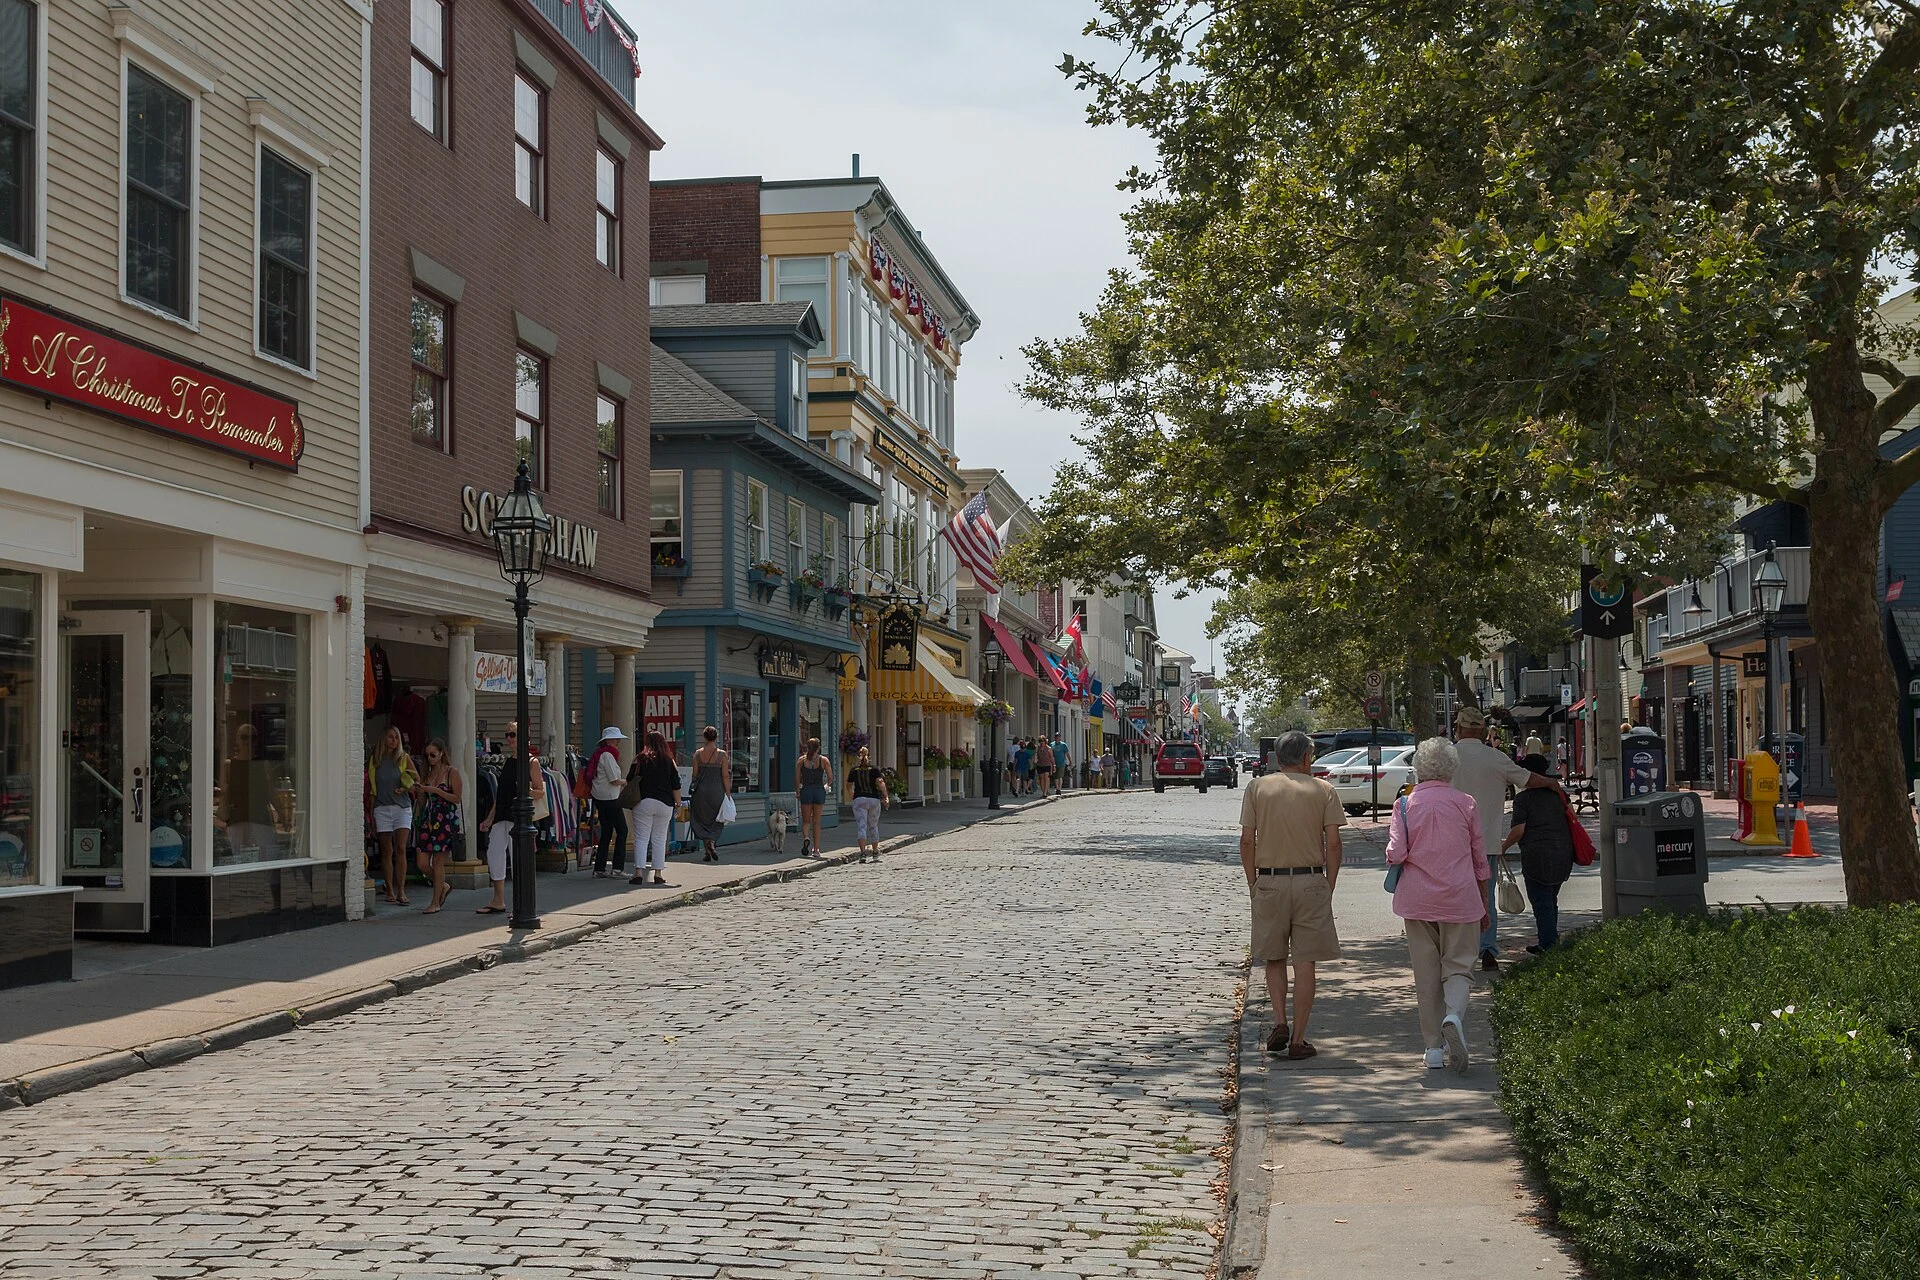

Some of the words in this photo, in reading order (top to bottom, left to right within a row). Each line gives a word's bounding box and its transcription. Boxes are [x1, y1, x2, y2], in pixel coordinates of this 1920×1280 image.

[22, 331, 65, 378] A
[65, 336, 162, 414] Christmas
[166, 375, 199, 424] To
[200, 385, 284, 453] Remember
[462, 485, 598, 568] SCSHAW
[873, 691, 908, 700] BRICK
[911, 691, 948, 700] ALLEY
[644, 695, 682, 717] ART
[923, 705, 948, 713] BRICK
[1657, 842, 1693, 854] mercury
